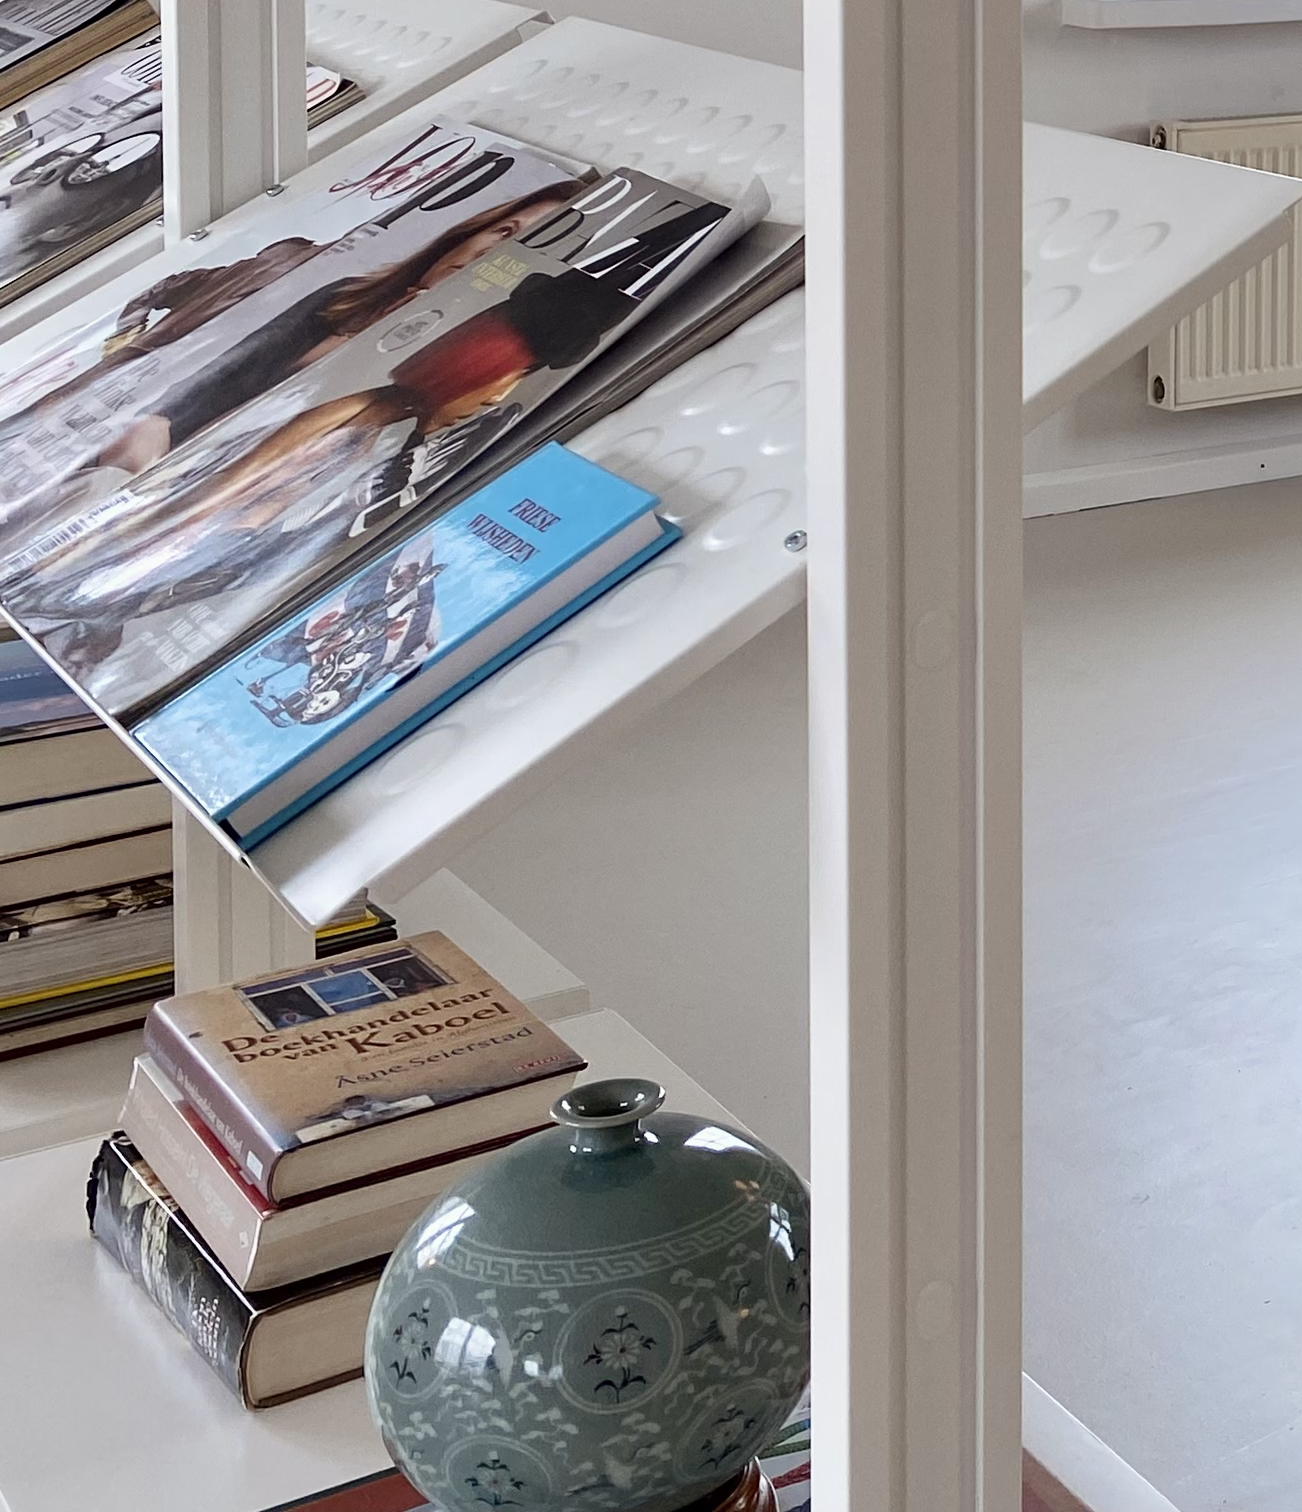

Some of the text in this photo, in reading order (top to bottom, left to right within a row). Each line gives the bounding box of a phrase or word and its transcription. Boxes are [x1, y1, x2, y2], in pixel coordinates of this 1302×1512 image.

[514, 174, 734, 301] BAZA
[467, 513, 540, 565] WIJSHEDEN
[508, 498, 561, 533] FRIESE
[221, 1034, 281, 1055] De
[233, 987, 492, 1064] boekhandelaar
[283, 1001, 511, 1062] van Kaboel
[409, 1026, 533, 1068] Seierstad
